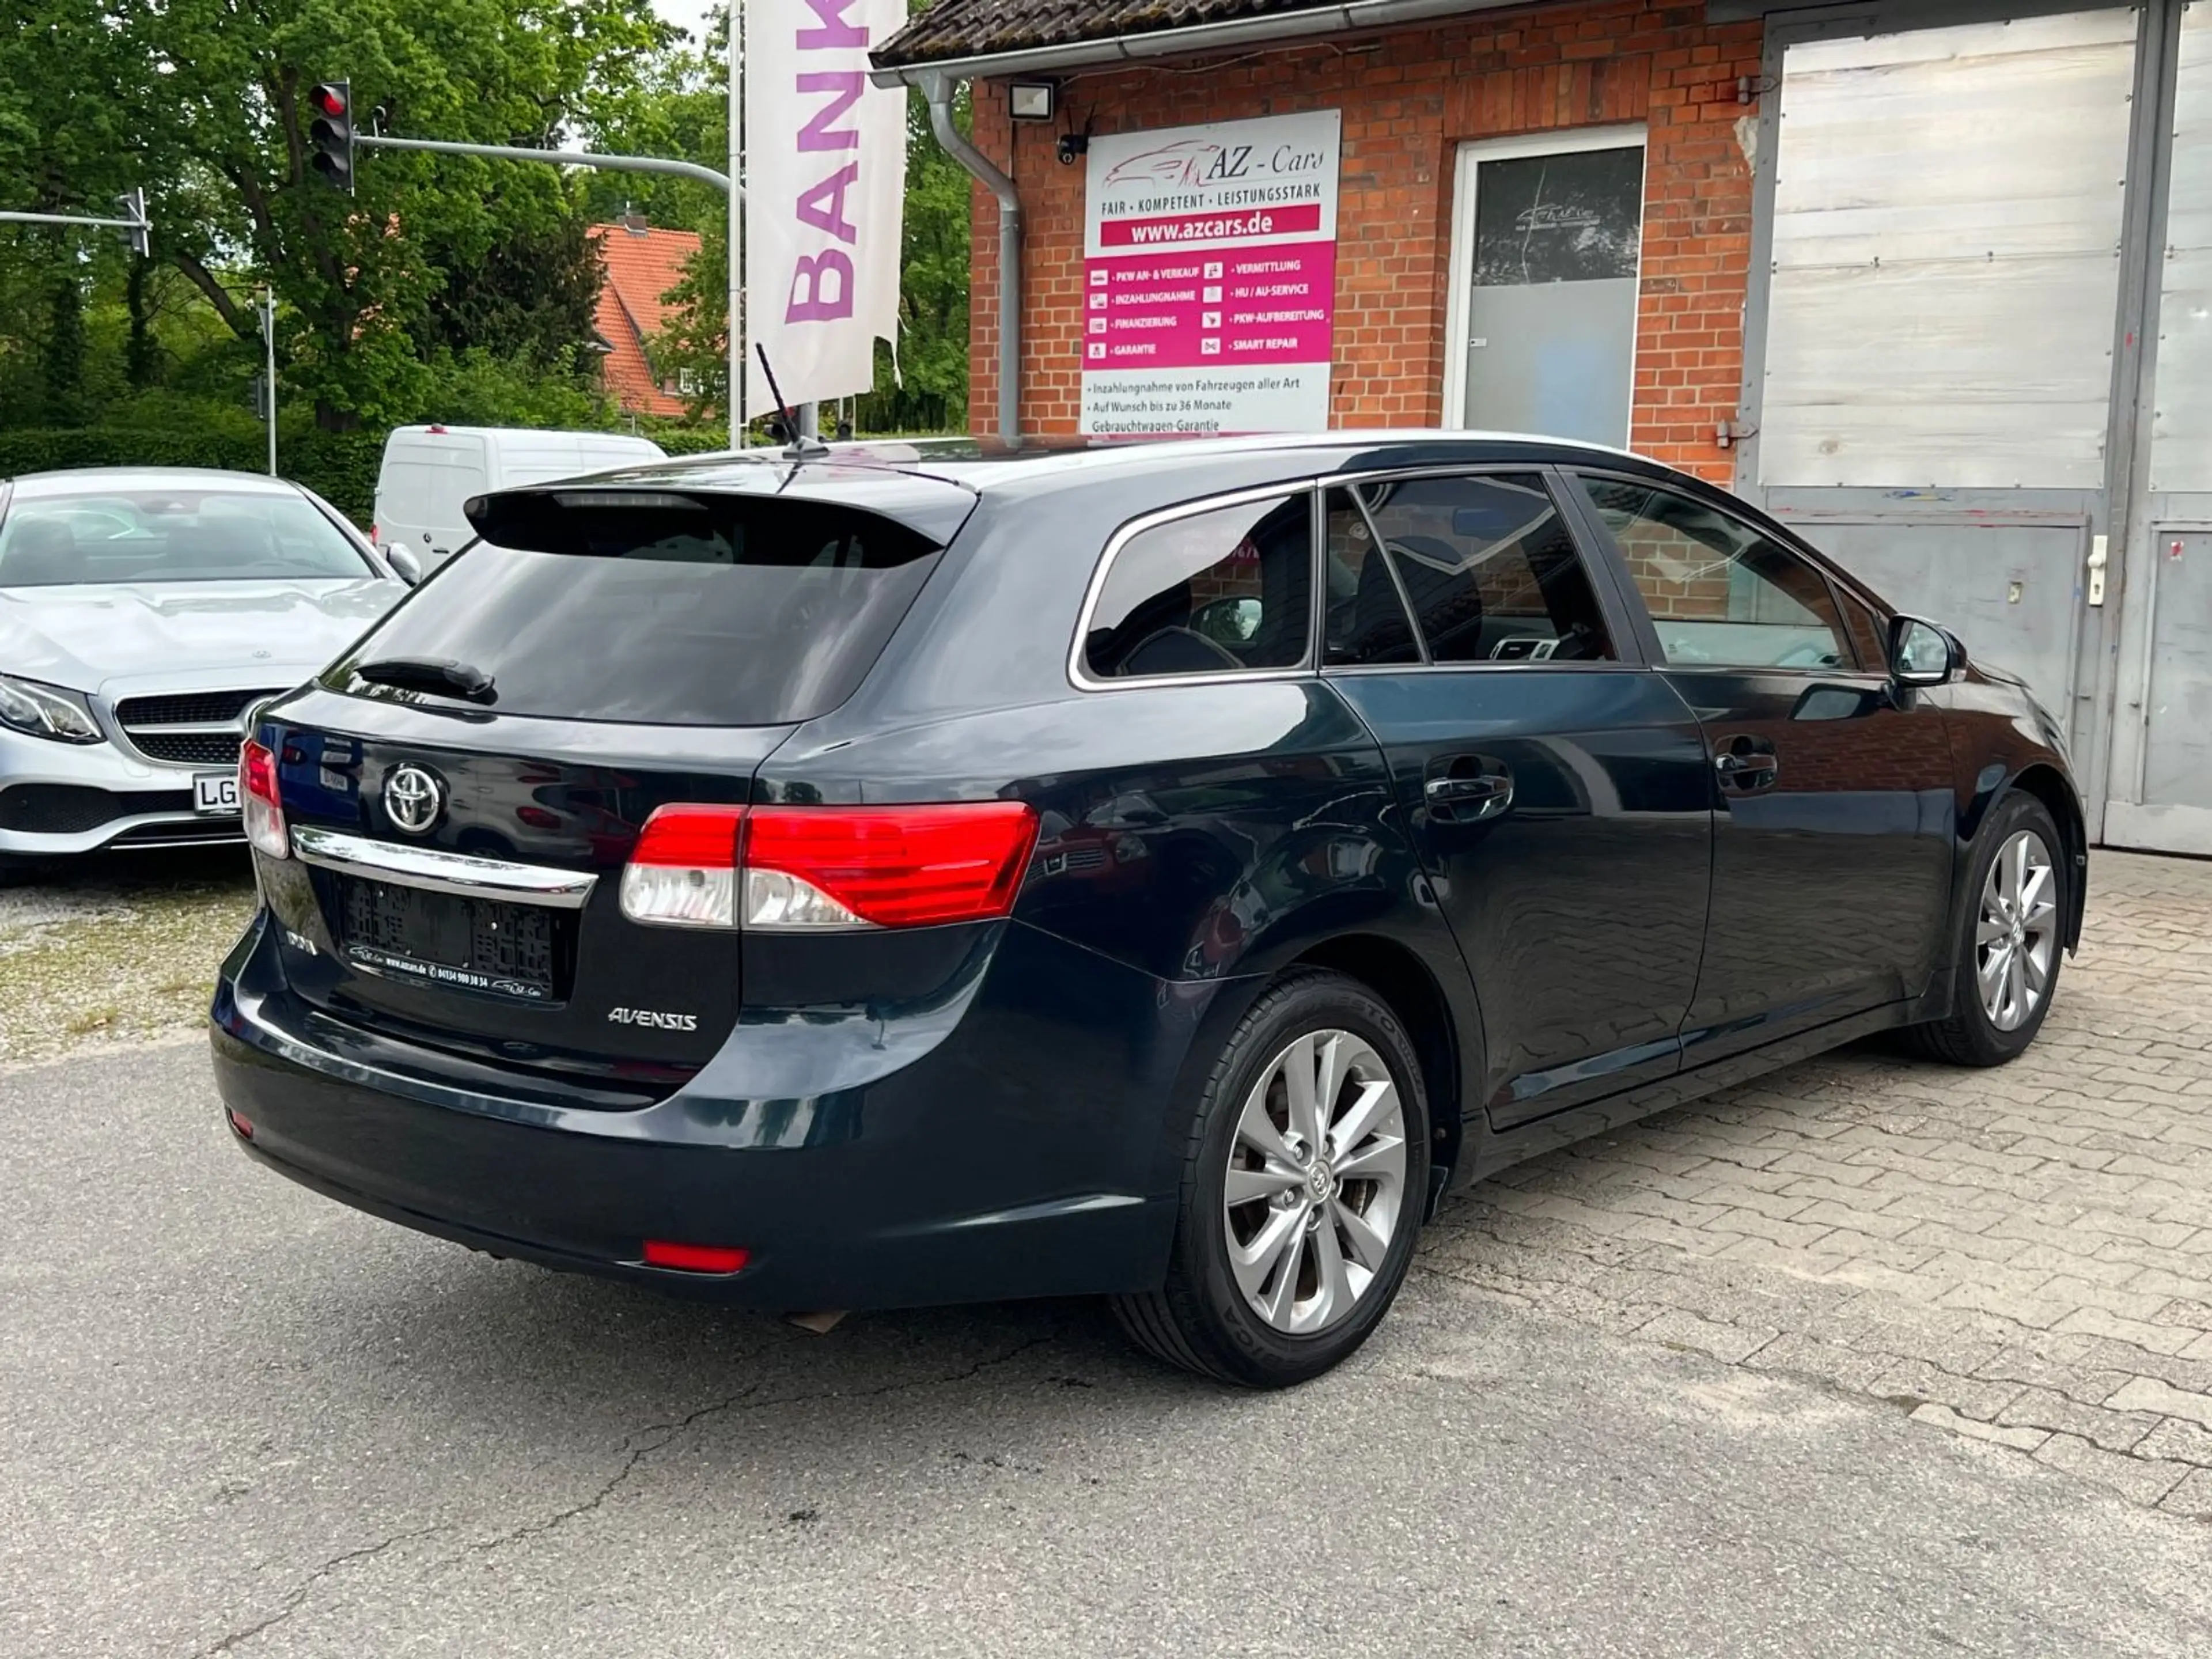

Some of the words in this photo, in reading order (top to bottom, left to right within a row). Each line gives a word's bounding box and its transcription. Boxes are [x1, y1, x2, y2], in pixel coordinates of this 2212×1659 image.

[1206, 145, 1253, 180] AZ
[1272, 145, 1324, 173] Cars
[1101, 201, 1126, 216] FAIR
[1138, 194, 1205, 213] KOMPETENT
[1217, 183, 1321, 206] LEISTUNGSSTARK
[1131, 211, 1273, 243] www.azcars.de
[1116, 271, 1136, 282] PKW
[1160, 267, 1200, 279] VERKAUF
[1236, 260, 1301, 275] VERMITTLUNG
[1115, 290, 1196, 305] INZAHLUNGNAHME
[1234, 287, 1249, 298] HU
[1255, 283, 1309, 297] AU-SERVICE
[1114, 316, 1177, 329] FINANZIERUNG
[1233, 309, 1324, 324] PKW-AUFBEREITUNG
[1113, 343, 1157, 355] GARANTIE
[1233, 339, 1264, 351] SMART
[1265, 338, 1298, 350] REPAIR
[1093, 381, 1173, 396] Inzahlungnahme
[1175, 382, 1194, 392] von
[1195, 380, 1255, 393] Fahrzeugen
[1257, 378, 1281, 390] aller
[1282, 377, 1300, 389] Art
[1093, 401, 1109, 413] Auf
[1111, 401, 1147, 412] Wunsch
[1150, 400, 1164, 412] bis
[1165, 403, 1177, 412] zu
[1179, 400, 1192, 411] 36
[1194, 399, 1232, 411] Monate
[200, 781, 236, 805] LG
[608, 1007, 698, 1031] AVENSIS
